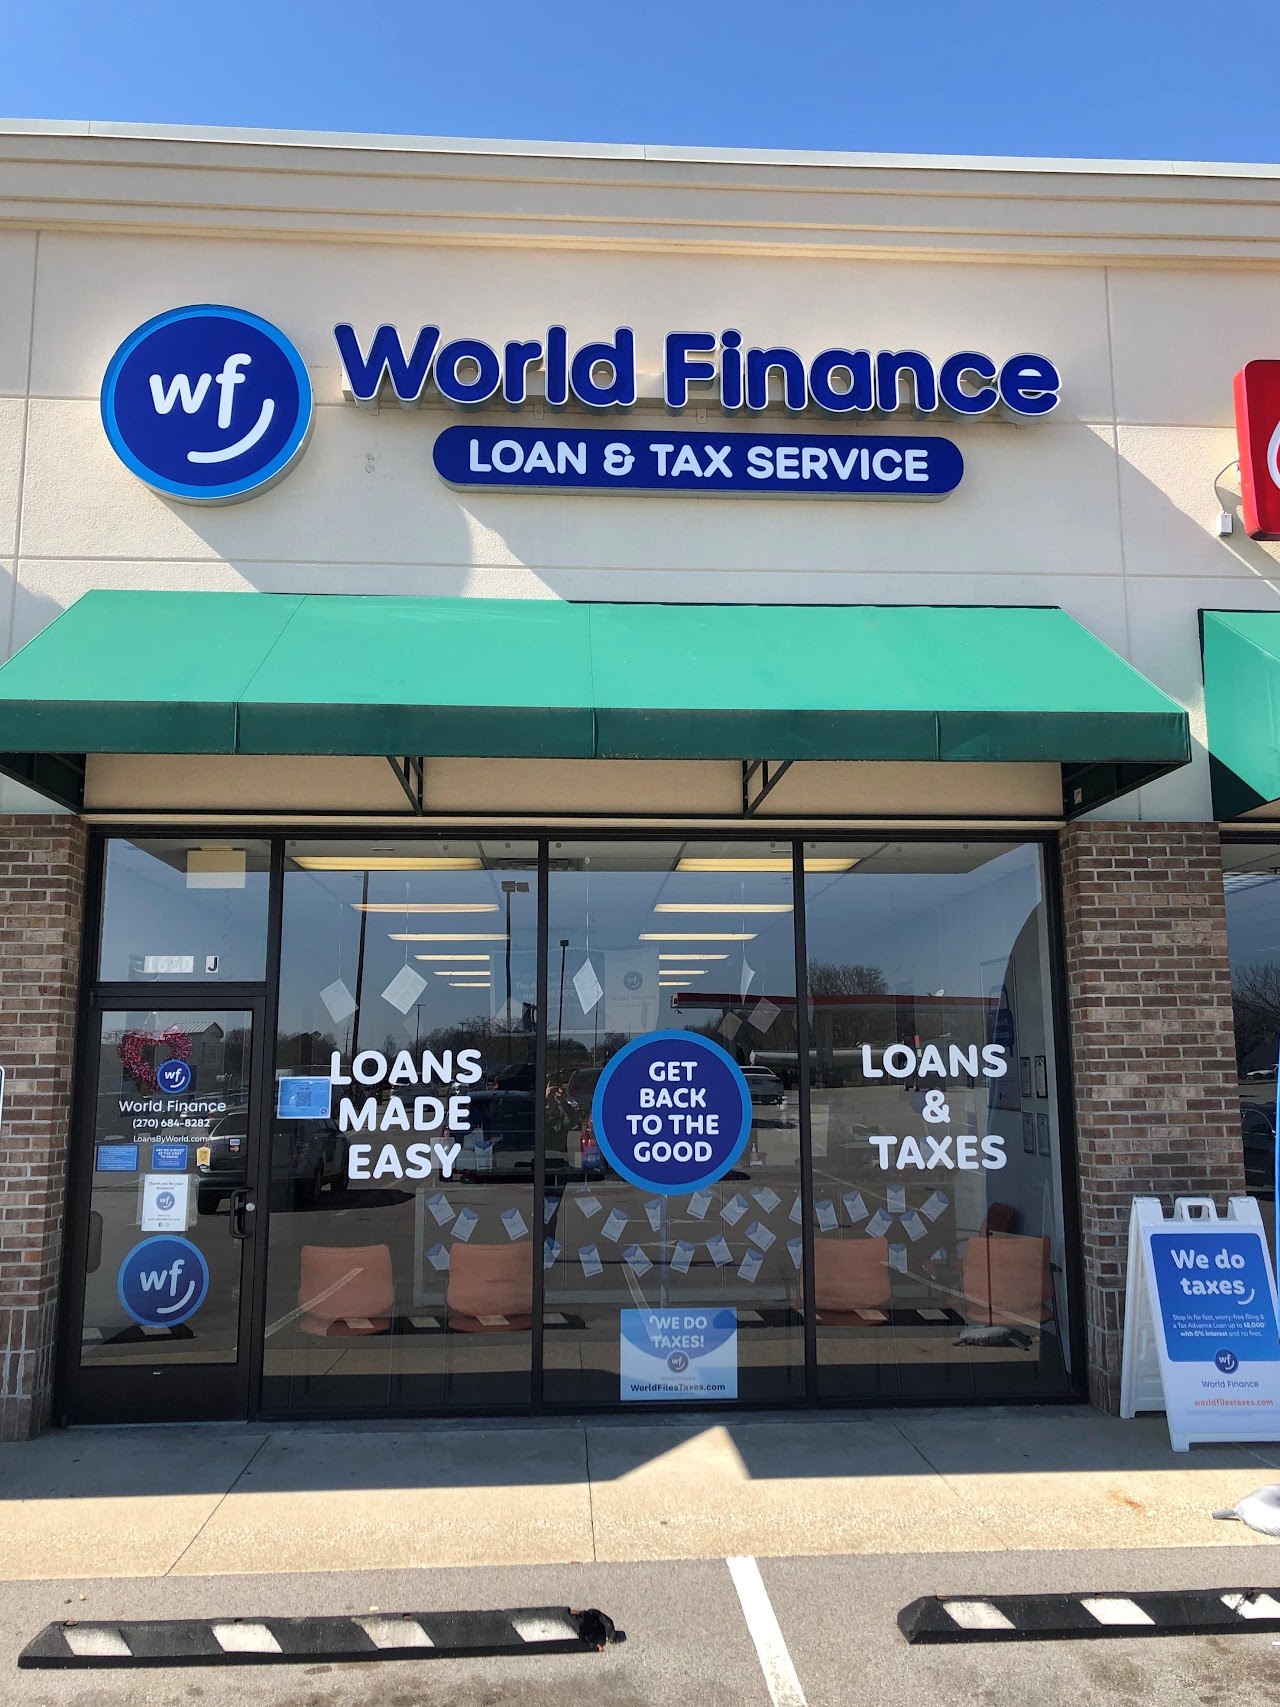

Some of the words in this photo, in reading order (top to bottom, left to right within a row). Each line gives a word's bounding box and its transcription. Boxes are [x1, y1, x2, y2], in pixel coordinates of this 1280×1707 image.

[332, 322, 638, 409] World
[664, 328, 1062, 416] Finance
[149, 353, 252, 428] wf
[469, 438, 587, 475] LOAN
[603, 442, 635, 476] &
[649, 443, 733, 478] TAX
[746, 445, 929, 482] SERVICE
[207, 956, 218, 972] J
[331, 1049, 483, 1085] LOANS
[862, 1044, 1008, 1078] LOANS
[164, 1068, 182, 1082] wf
[648, 1062, 698, 1082] GET
[119, 1100, 162, 1112] World
[167, 1100, 226, 1112] Finance
[640, 1088, 706, 1108] BACK
[922, 1090, 950, 1124] &
[132, 1118, 158, 1129] (270)
[160, 1118, 210, 1128] 684-8282
[338, 1096, 471, 1131] MADE
[626, 1114, 662, 1136] TO
[668, 1114, 720, 1135] THE
[134, 1135, 208, 1144] LoansByWorld.com
[348, 1142, 462, 1179] EASY
[634, 1141, 712, 1162] GOOD
[868, 1135, 1008, 1170] TAXES
[1170, 1249, 1209, 1270] We
[1214, 1248, 1245, 1270] do
[140, 1259, 185, 1296] wf
[1180, 1278, 1246, 1296] taxes
[655, 1316, 680, 1330] WE
[684, 1316, 708, 1330] DO
[652, 1336, 704, 1348] TAXES!
[1218, 1354, 1232, 1366] wf
[630, 1384, 726, 1392] WorldFilesTaxes.com
